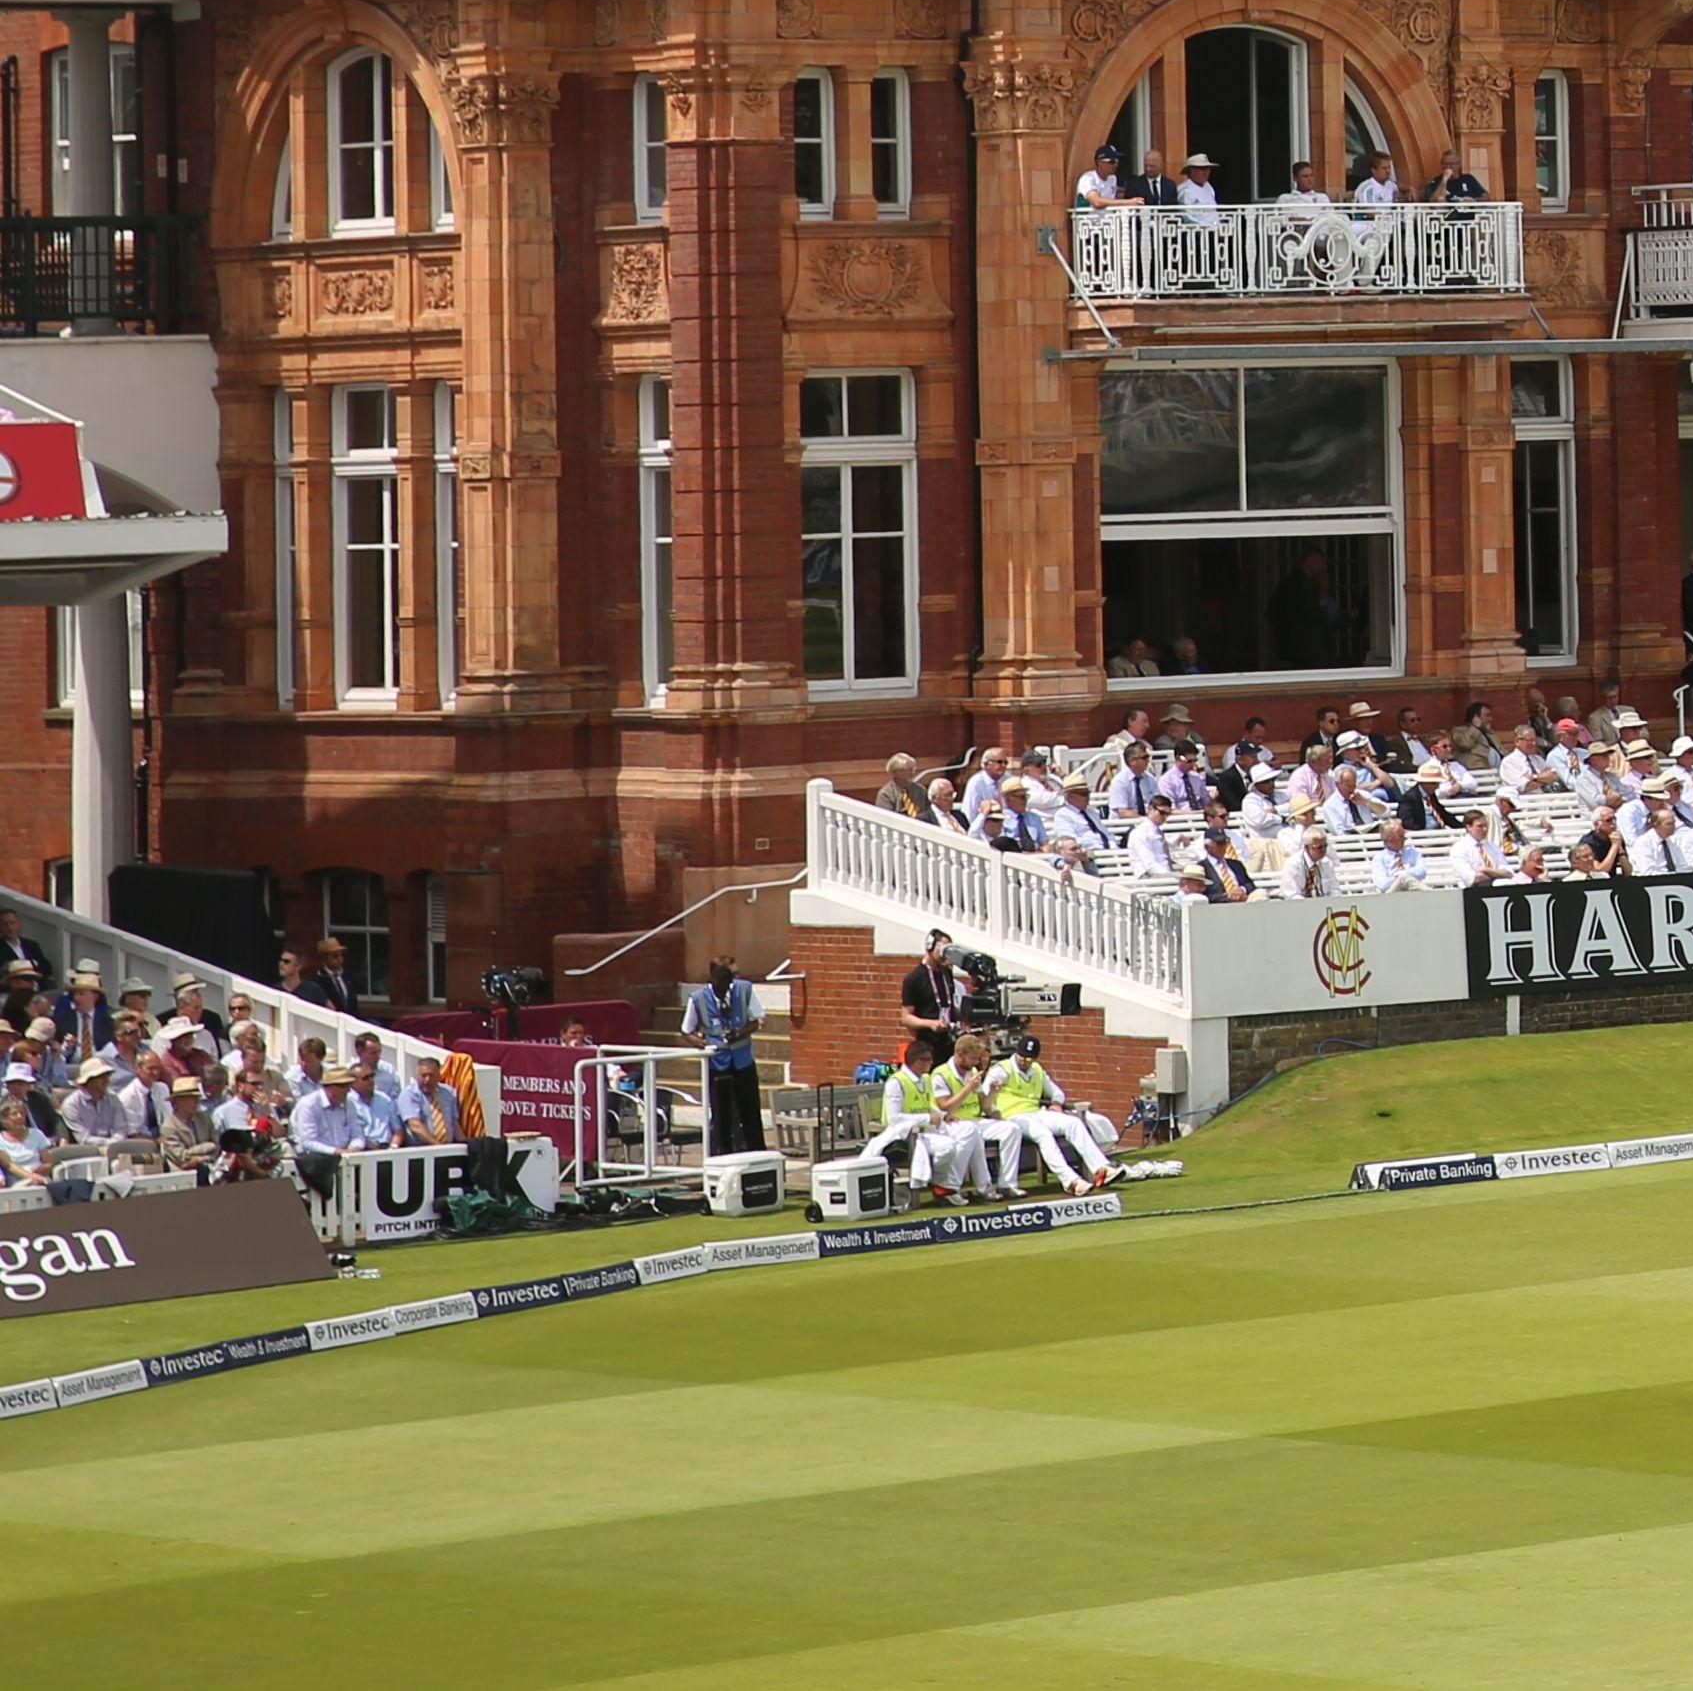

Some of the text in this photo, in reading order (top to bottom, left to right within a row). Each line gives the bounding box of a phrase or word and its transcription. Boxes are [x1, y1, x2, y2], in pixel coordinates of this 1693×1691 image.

[502, 1075, 561, 1095] MEMBERS
[500, 1099, 592, 1121] ROVER TICKES
[1390, 1160, 1494, 1185] Private Banking
[1520, 1150, 1603, 1171] Investec
[1615, 1144, 1644, 1161] Asset
[374, 1220, 411, 1234] PITCH
[1051, 1198, 1114, 1219] vestec
[822, 1209, 1046, 1249] Wealth & Investment Investec
[0, 1226, 136, 1302] gan
[651, 1238, 817, 1277] Investec Asset Management
[491, 1265, 638, 1308] Investec Private Banking
[326, 1297, 475, 1342] Investec Corporate Banking
[161, 1348, 226, 1376] Investec
[227, 1342, 257, 1360] Wealth
[264, 1333, 308, 1353] Investment
[0, 1367, 142, 1409] vestec Asset Management
